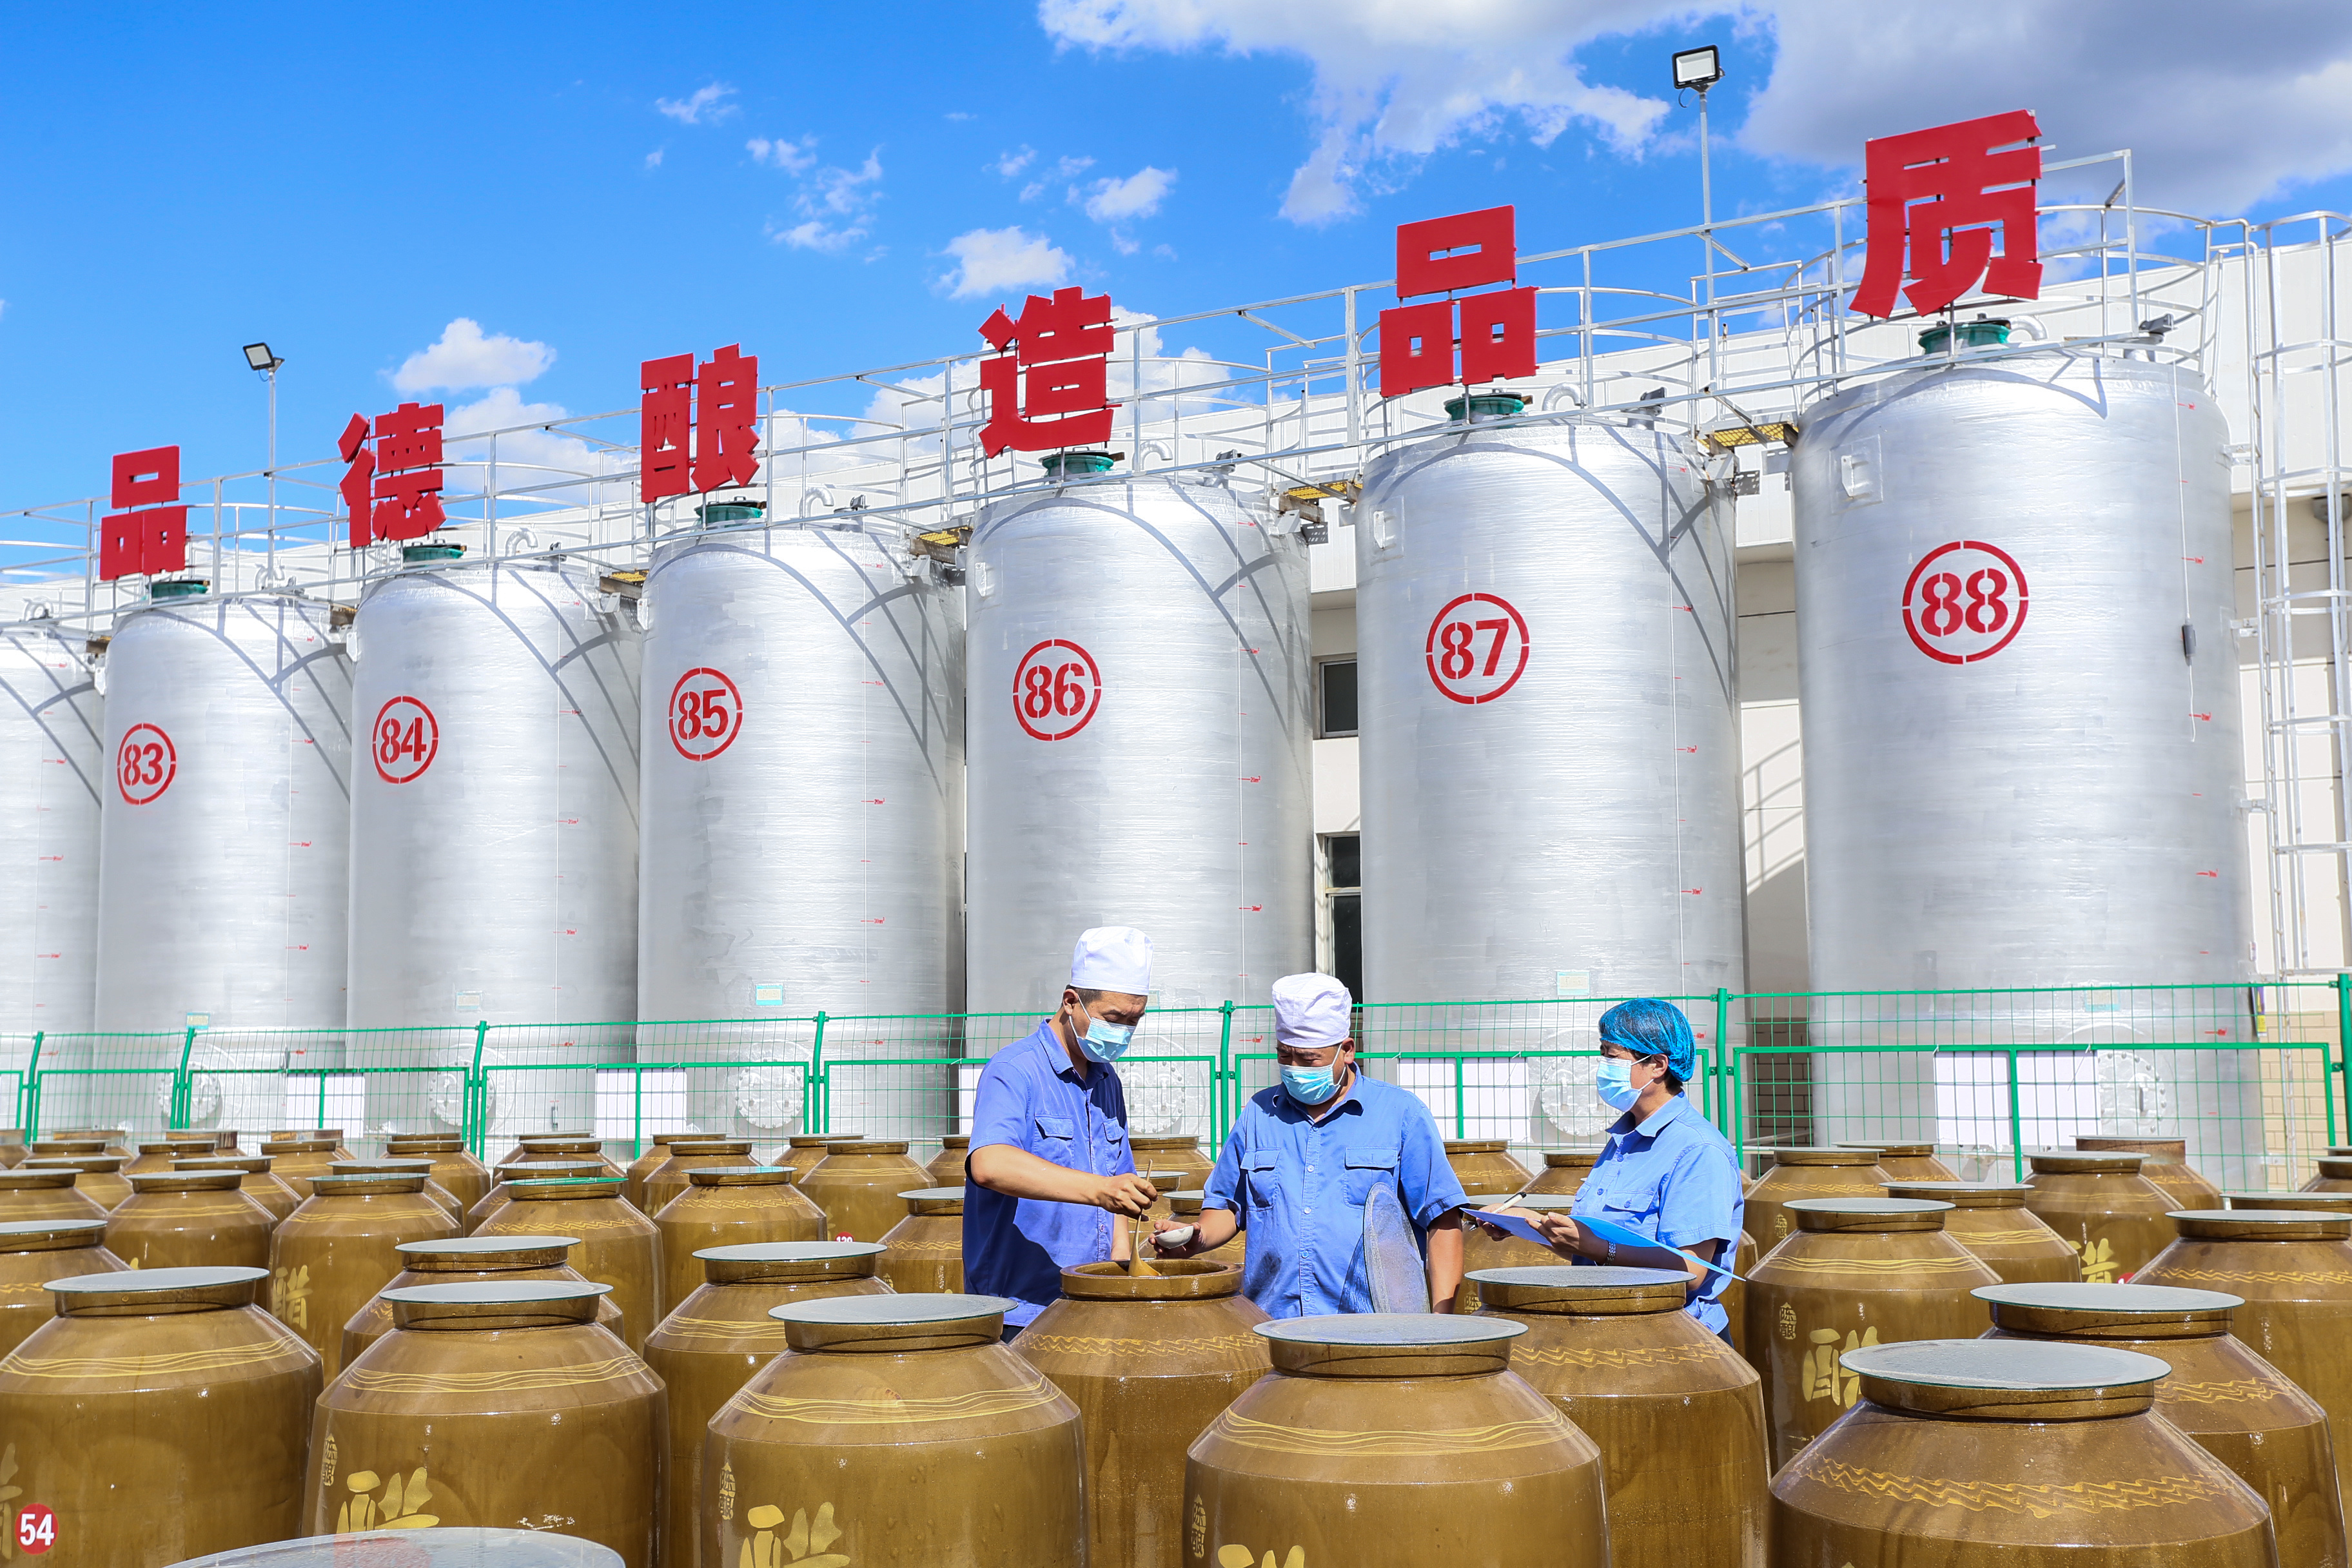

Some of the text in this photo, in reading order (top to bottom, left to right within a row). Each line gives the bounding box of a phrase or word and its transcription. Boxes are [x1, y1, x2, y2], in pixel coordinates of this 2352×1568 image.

[100, 110, 2043, 581] 品 德 酿 造 品 质
[1921, 568, 2008, 637] 88
[1441, 618, 1509, 680] 87
[678, 689, 729, 740] 85
[1024, 663, 1086, 718] 86
[124, 743, 164, 786] 83
[380, 717, 427, 764] 84
[19, 1513, 55, 1546] 54
